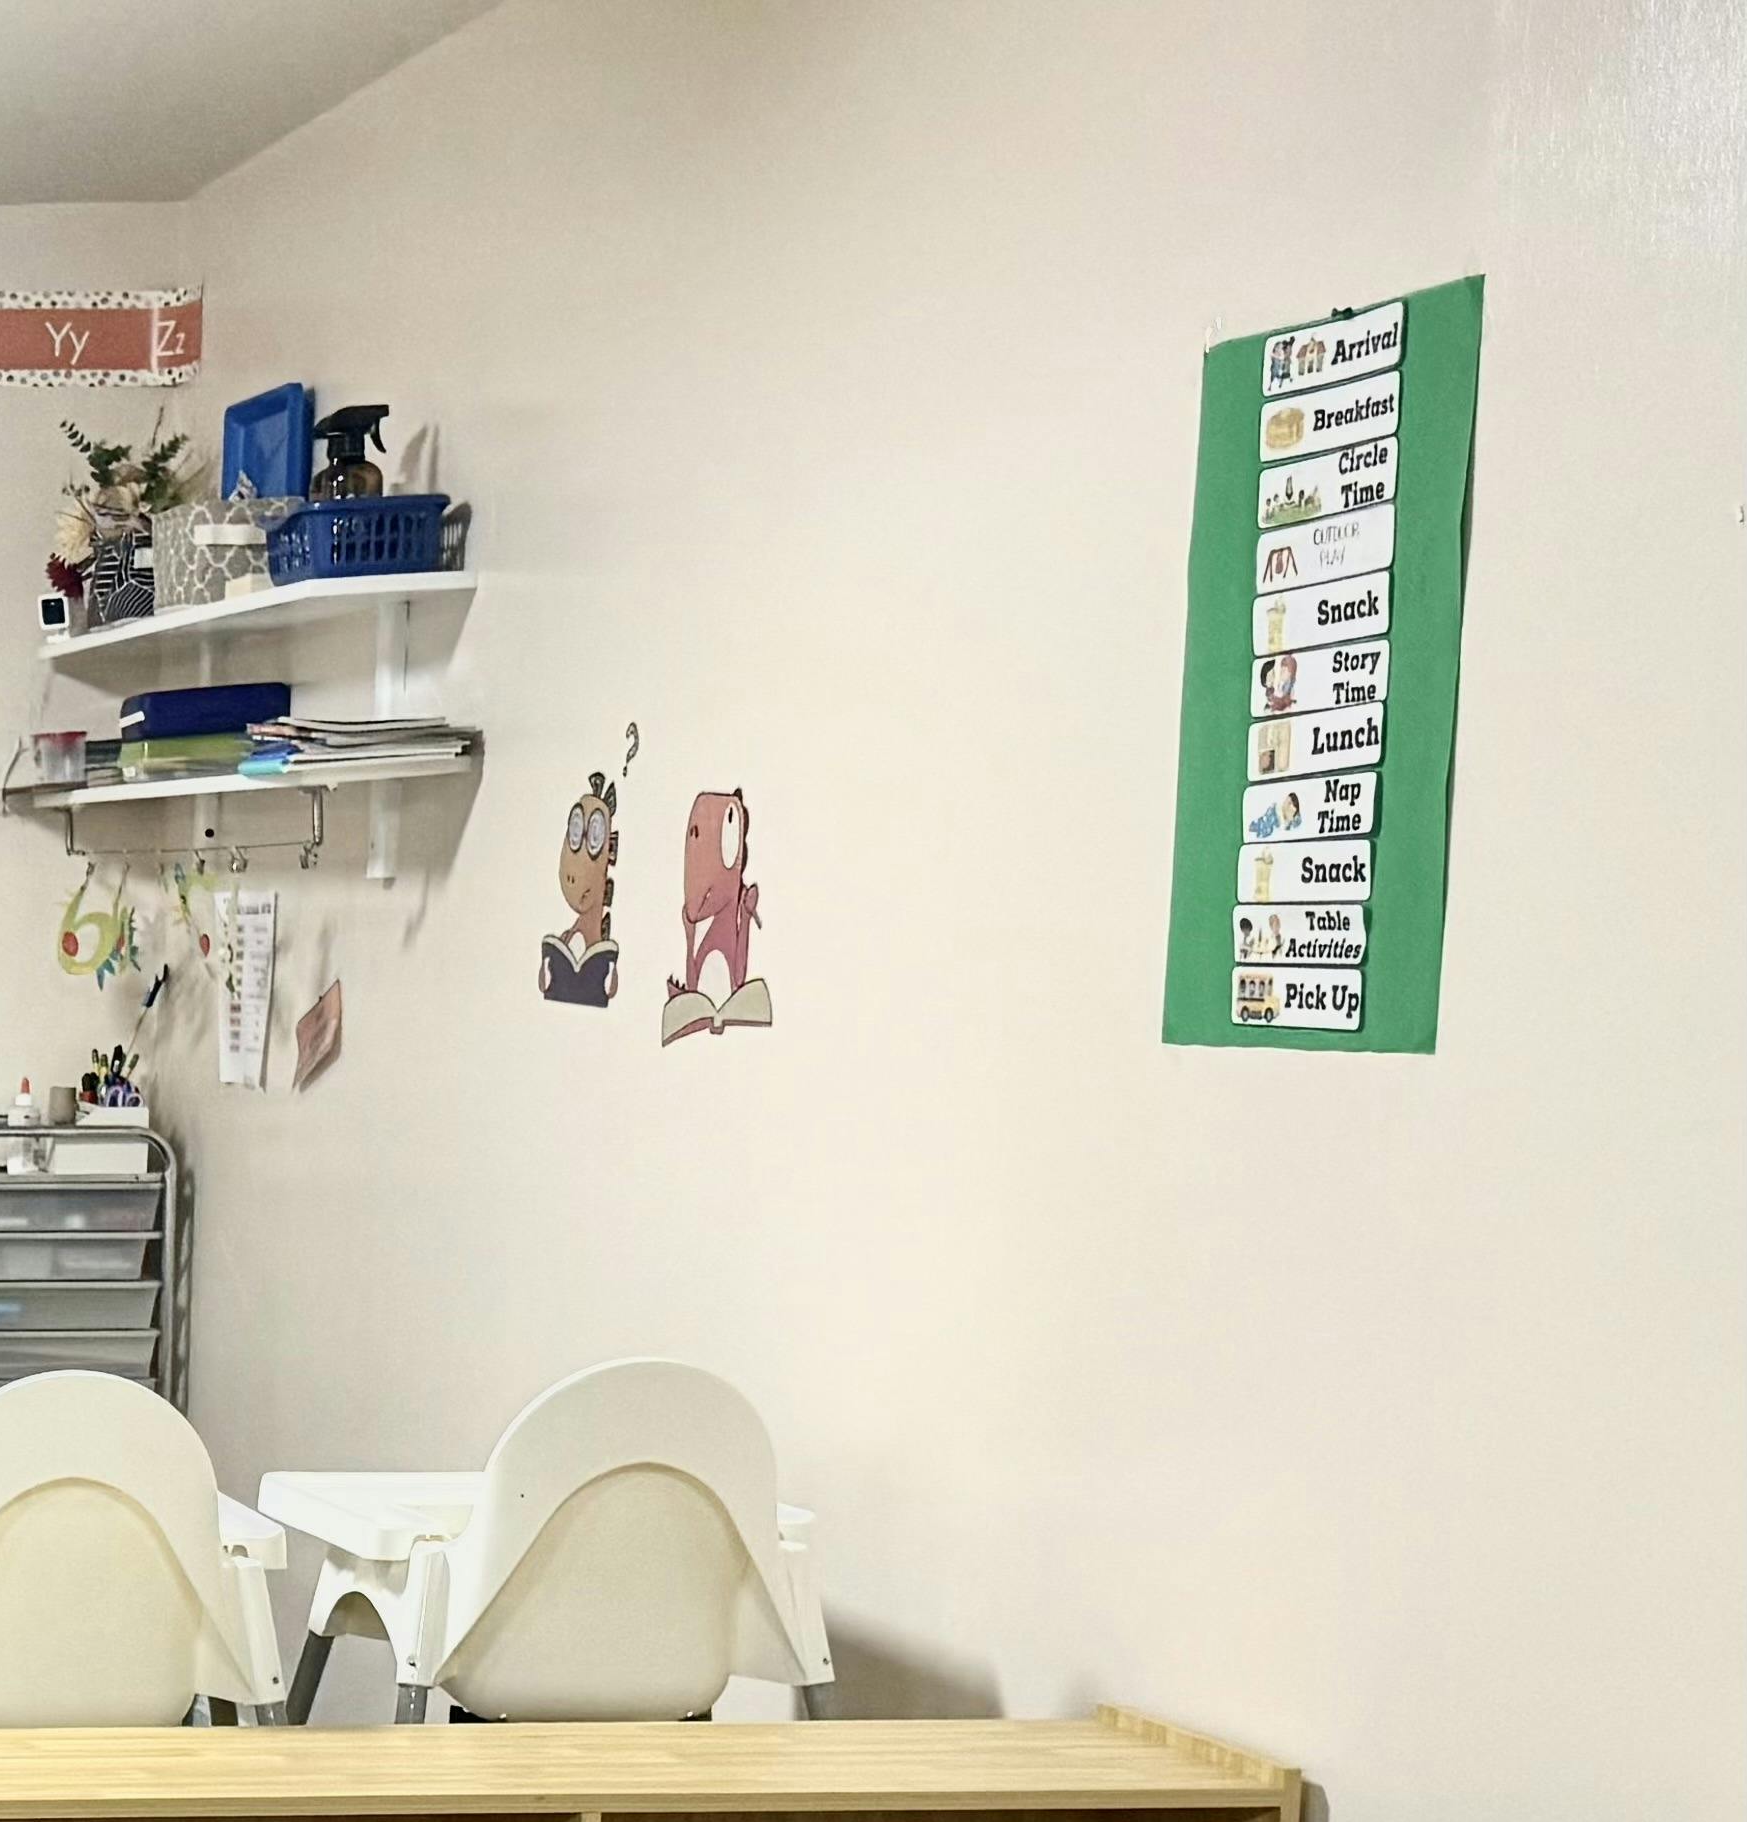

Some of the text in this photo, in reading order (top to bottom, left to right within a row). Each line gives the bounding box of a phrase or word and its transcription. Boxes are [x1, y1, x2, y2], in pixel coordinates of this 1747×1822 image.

[47, 323, 90, 366] Yy
[158, 322, 186, 357] Zz
[1331, 322, 1399, 366] Arrival
[1313, 394, 1395, 432] Breakfast
[1338, 445, 1388, 475] Circle
[1341, 480, 1385, 509] Time
[1317, 590, 1380, 627] Snack
[1332, 650, 1381, 675] Story
[1332, 682, 1377, 705] Time
[1311, 718, 1380, 755] Lunch
[1324, 779, 1361, 806] Nap
[1317, 811, 1361, 834] Time
[1301, 856, 1367, 884] Snack
[1305, 911, 1350, 931] Table
[1285, 938, 1362, 960] Activities
[1284, 983, 1359, 1018] Pick Up
